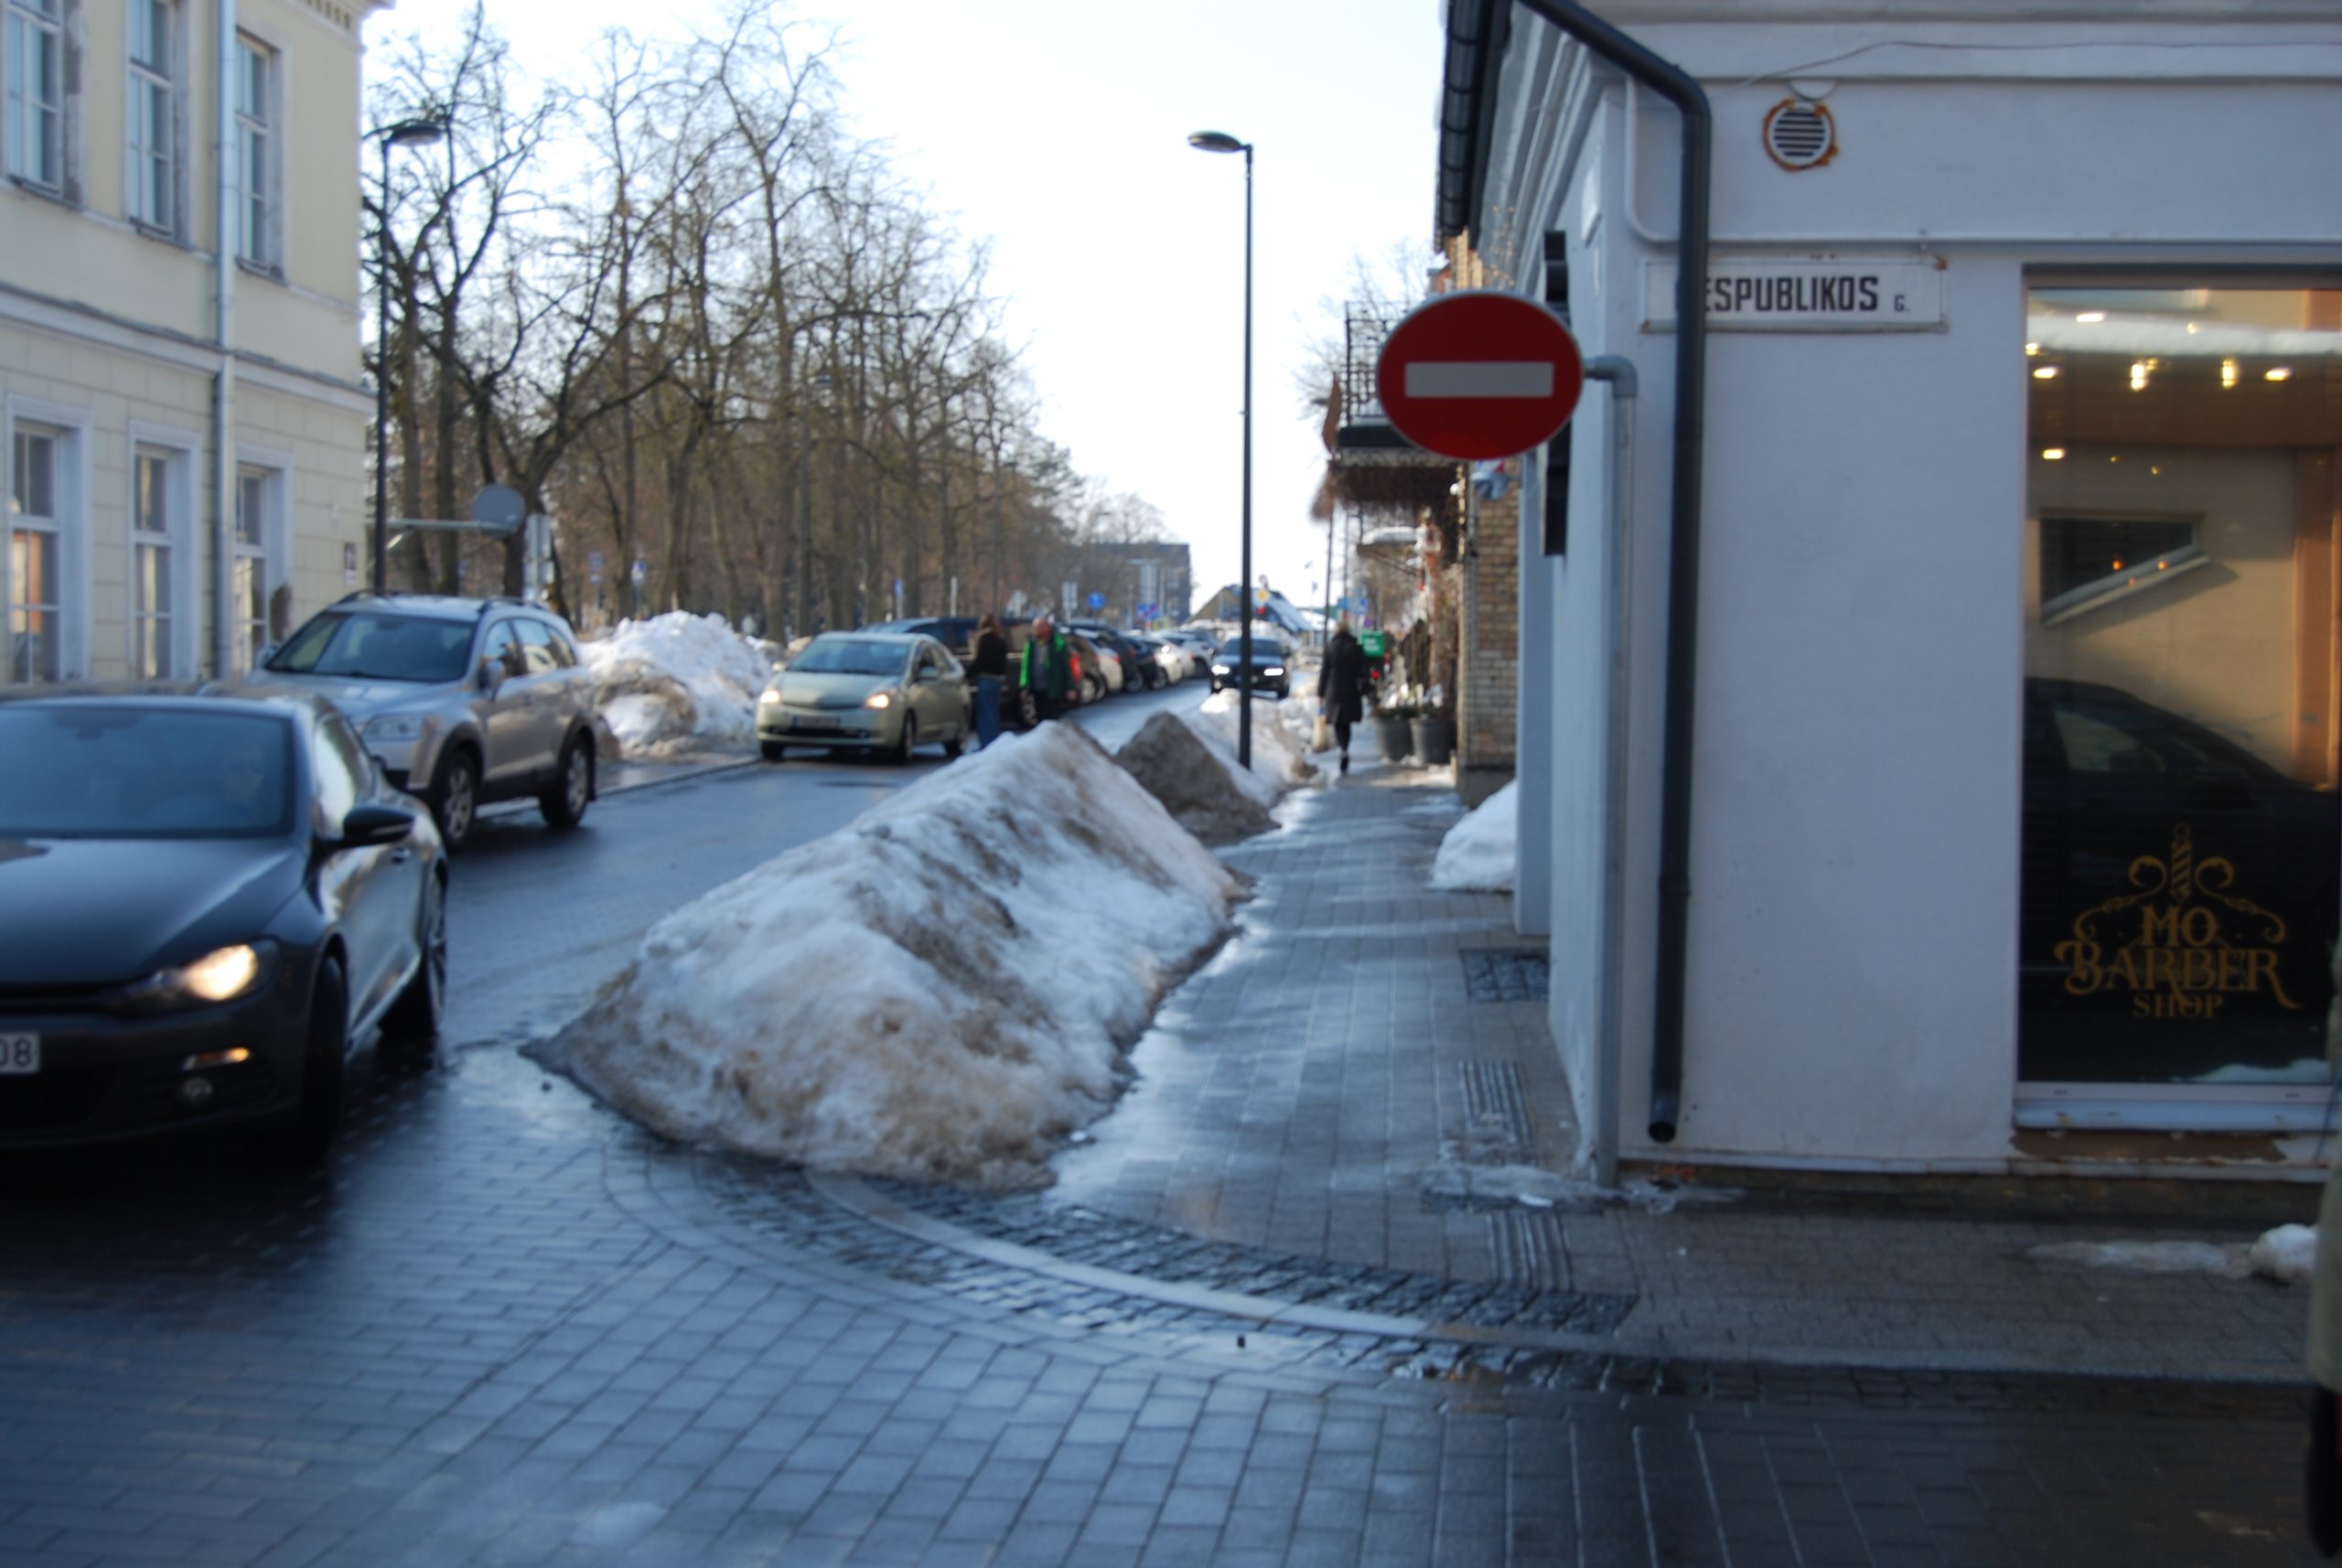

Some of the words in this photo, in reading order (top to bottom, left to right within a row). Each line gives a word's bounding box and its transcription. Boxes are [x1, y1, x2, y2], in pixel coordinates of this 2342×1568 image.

[1675, 276, 1879, 312] SPUBLIKOS
[2141, 906, 2218, 947] MO
[2054, 940, 2301, 1009] BARBER
[2133, 993, 2223, 1018] SHOP
